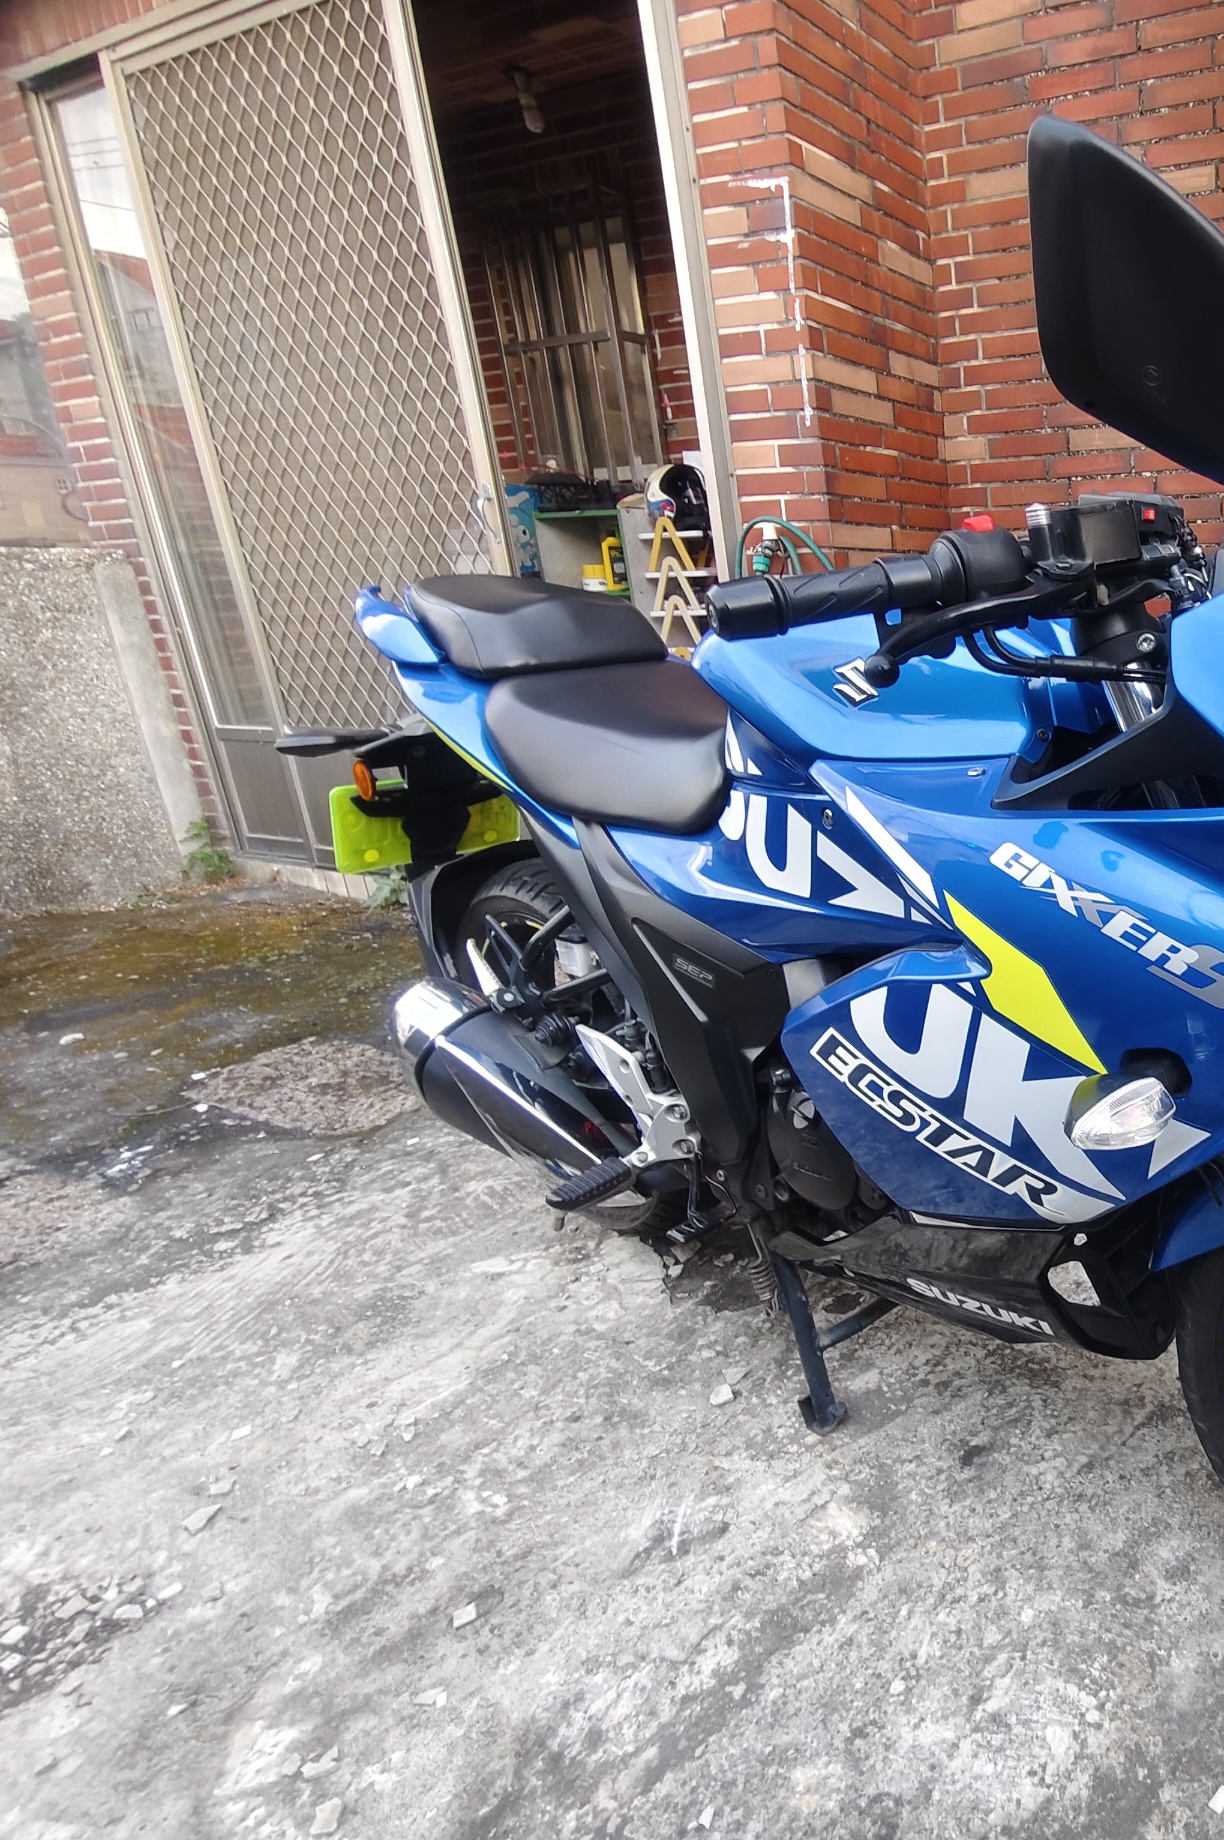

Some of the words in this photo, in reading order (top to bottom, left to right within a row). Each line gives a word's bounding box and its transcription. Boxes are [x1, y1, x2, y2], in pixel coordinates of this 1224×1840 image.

[989, 842, 1200, 976] GIXXER
[675, 957, 713, 980] SEP
[809, 1026, 1062, 1211] ECSTAR
[906, 1277, 1055, 1337] SUZUKI
